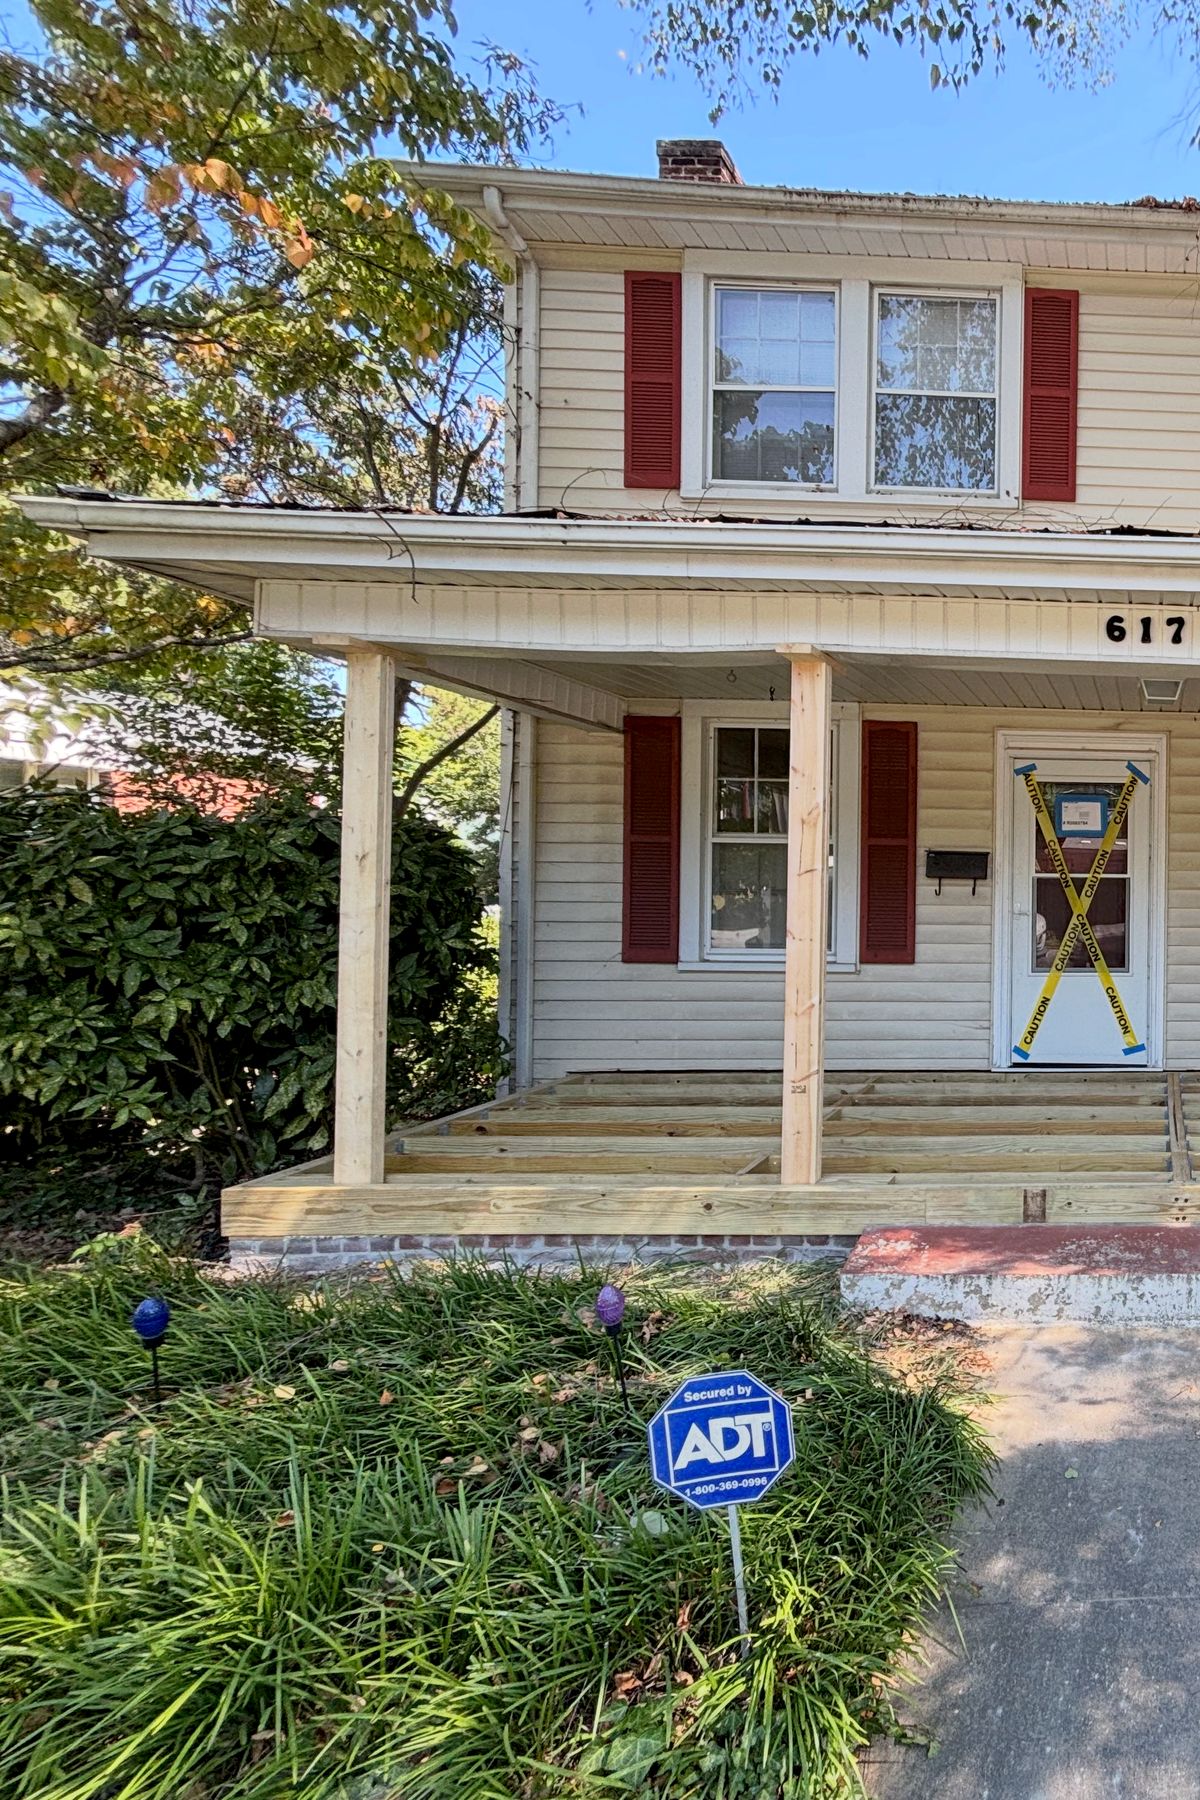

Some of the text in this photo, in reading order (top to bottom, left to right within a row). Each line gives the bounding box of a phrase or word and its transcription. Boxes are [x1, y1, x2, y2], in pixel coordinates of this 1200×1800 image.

[1106, 615, 1185, 644] 617
[1023, 772, 1044, 814] AUTION
[1114, 776, 1138, 825] CAUTION
[1048, 840, 1071, 889] CAUTION
[1085, 850, 1109, 898] CAUTION
[1055, 923, 1080, 972] CAUTION
[1076, 913, 1101, 962] CAUTION
[1023, 996, 1051, 1045] CAUTION
[1106, 986, 1131, 1035] CAUTION
[684, 1384, 752, 1402] Secured by
[674, 1412, 772, 1471] ADT
[684, 1476, 768, 1497] 1-800-369-0996
